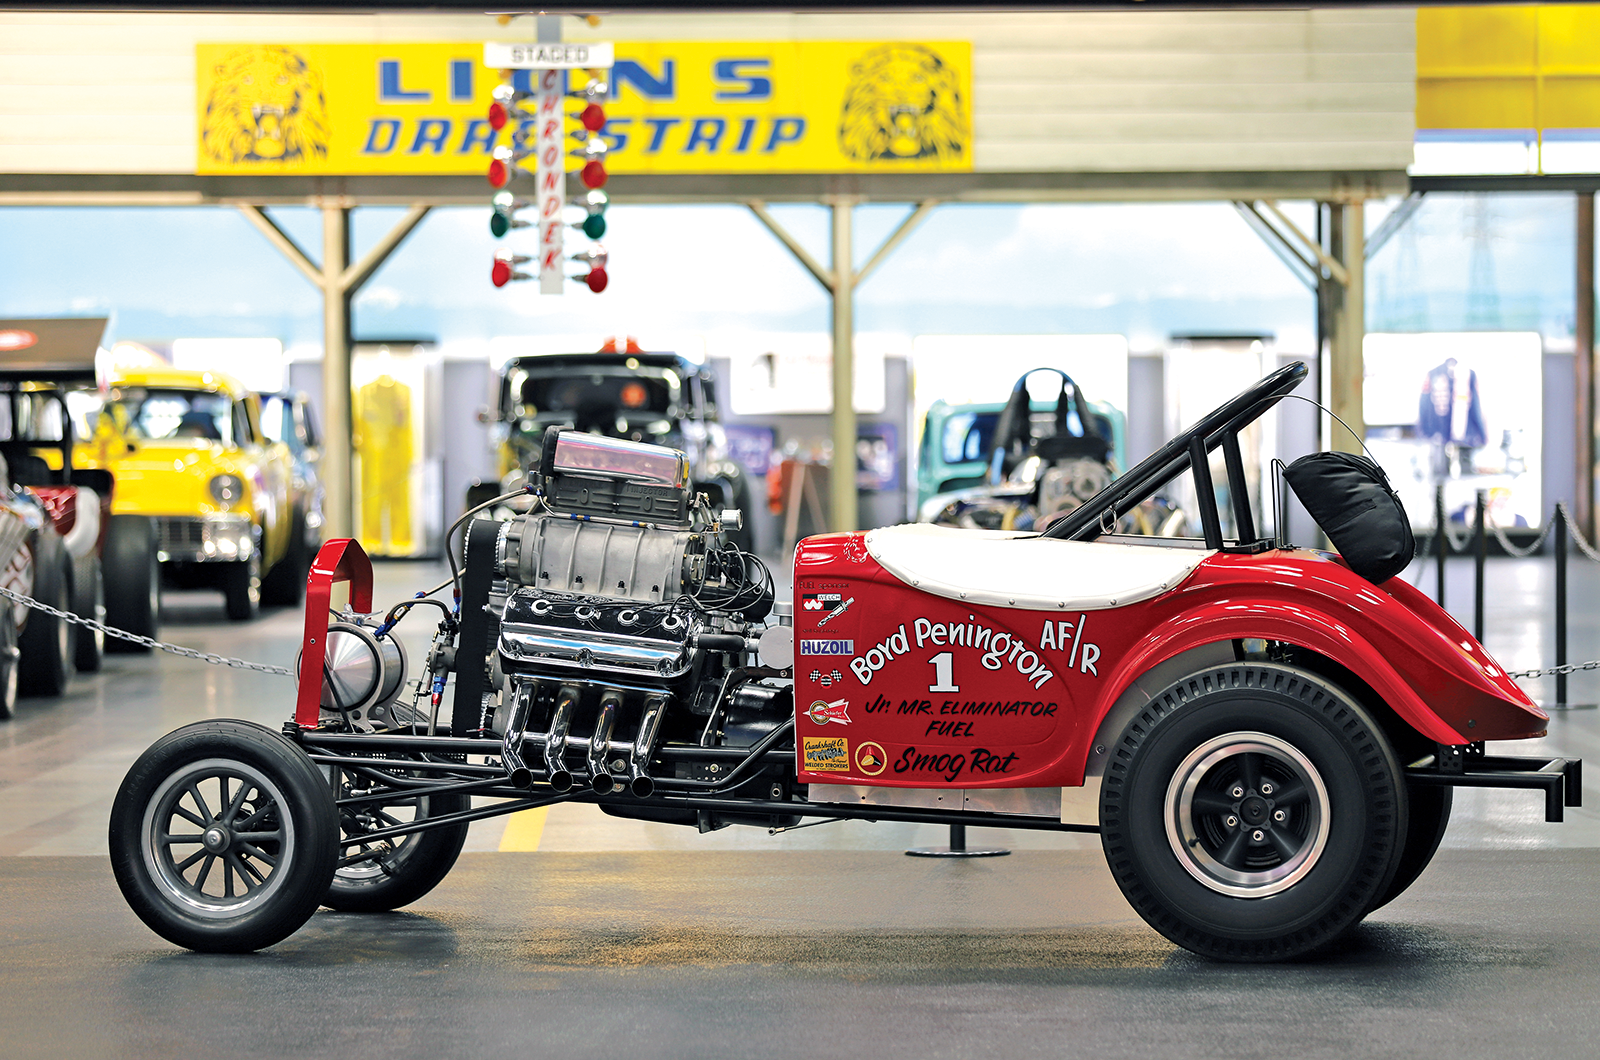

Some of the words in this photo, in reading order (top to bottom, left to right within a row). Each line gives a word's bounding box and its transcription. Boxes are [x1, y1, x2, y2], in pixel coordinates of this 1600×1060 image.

[597, 118, 805, 151] STRIP
[541, 68, 561, 271] CHRONDEK
[801, 640, 853, 655] HUZOIL
[849, 623, 911, 686] Boyd
[912, 614, 1054, 690] Penington
[1040, 613, 1101, 678] AF/R
[927, 652, 961, 693] 1
[897, 700, 934, 716] MR.
[940, 700, 1058, 717] ELIMINATOR
[925, 720, 975, 737] FUEL
[894, 746, 967, 782] Smog
[970, 747, 1020, 774] Rat
